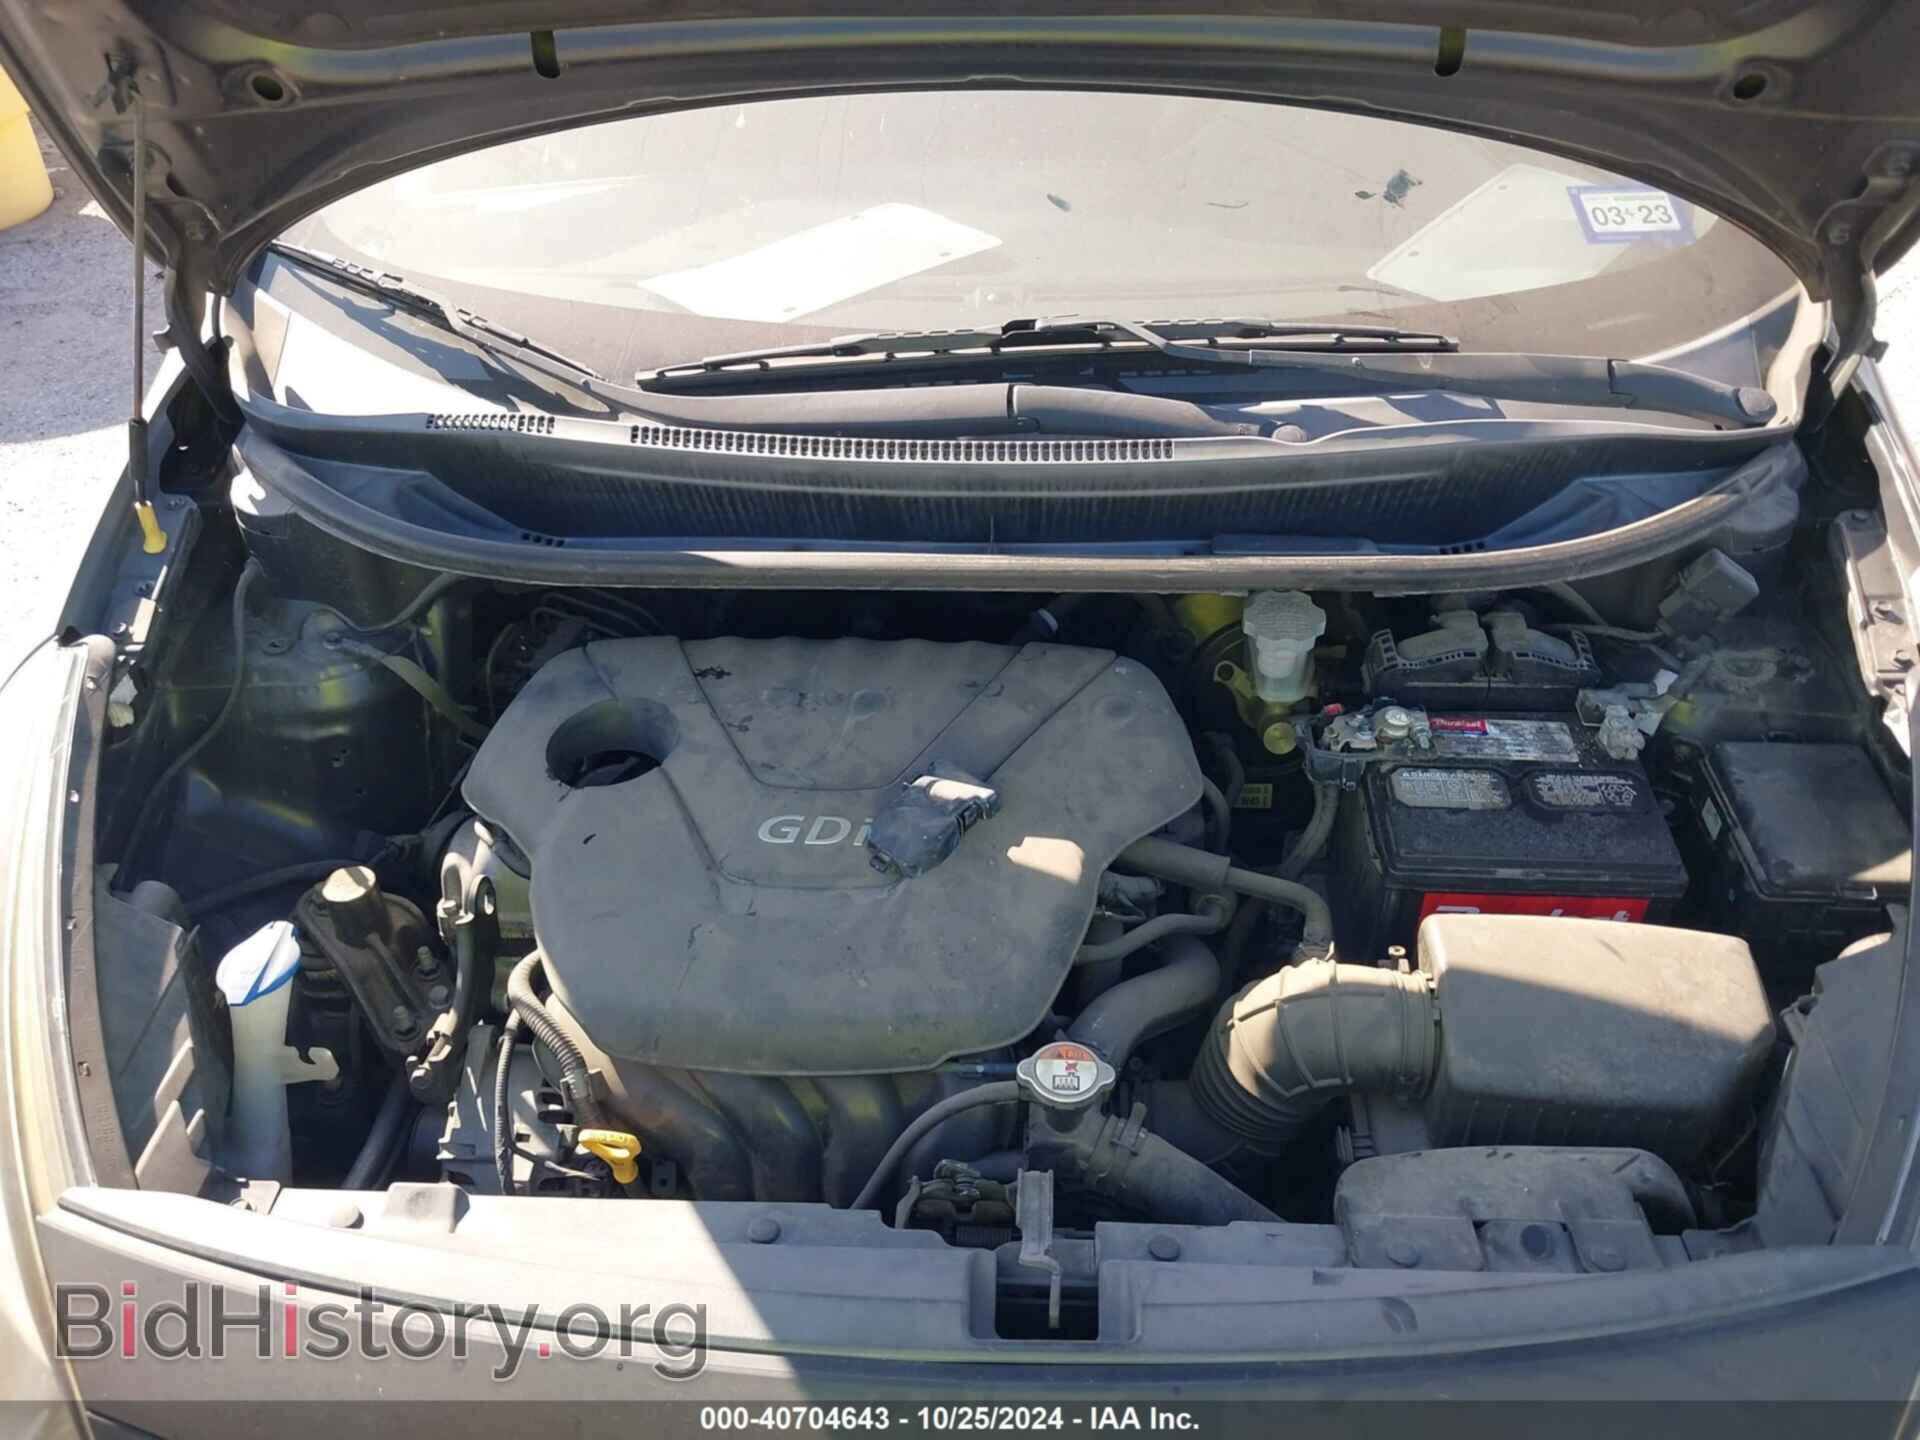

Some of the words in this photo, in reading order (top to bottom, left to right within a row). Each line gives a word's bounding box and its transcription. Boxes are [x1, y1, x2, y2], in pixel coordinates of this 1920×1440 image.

[1591, 206, 1626, 226] 03
[1637, 204, 1673, 224] 23
[757, 815, 874, 847] GDi
